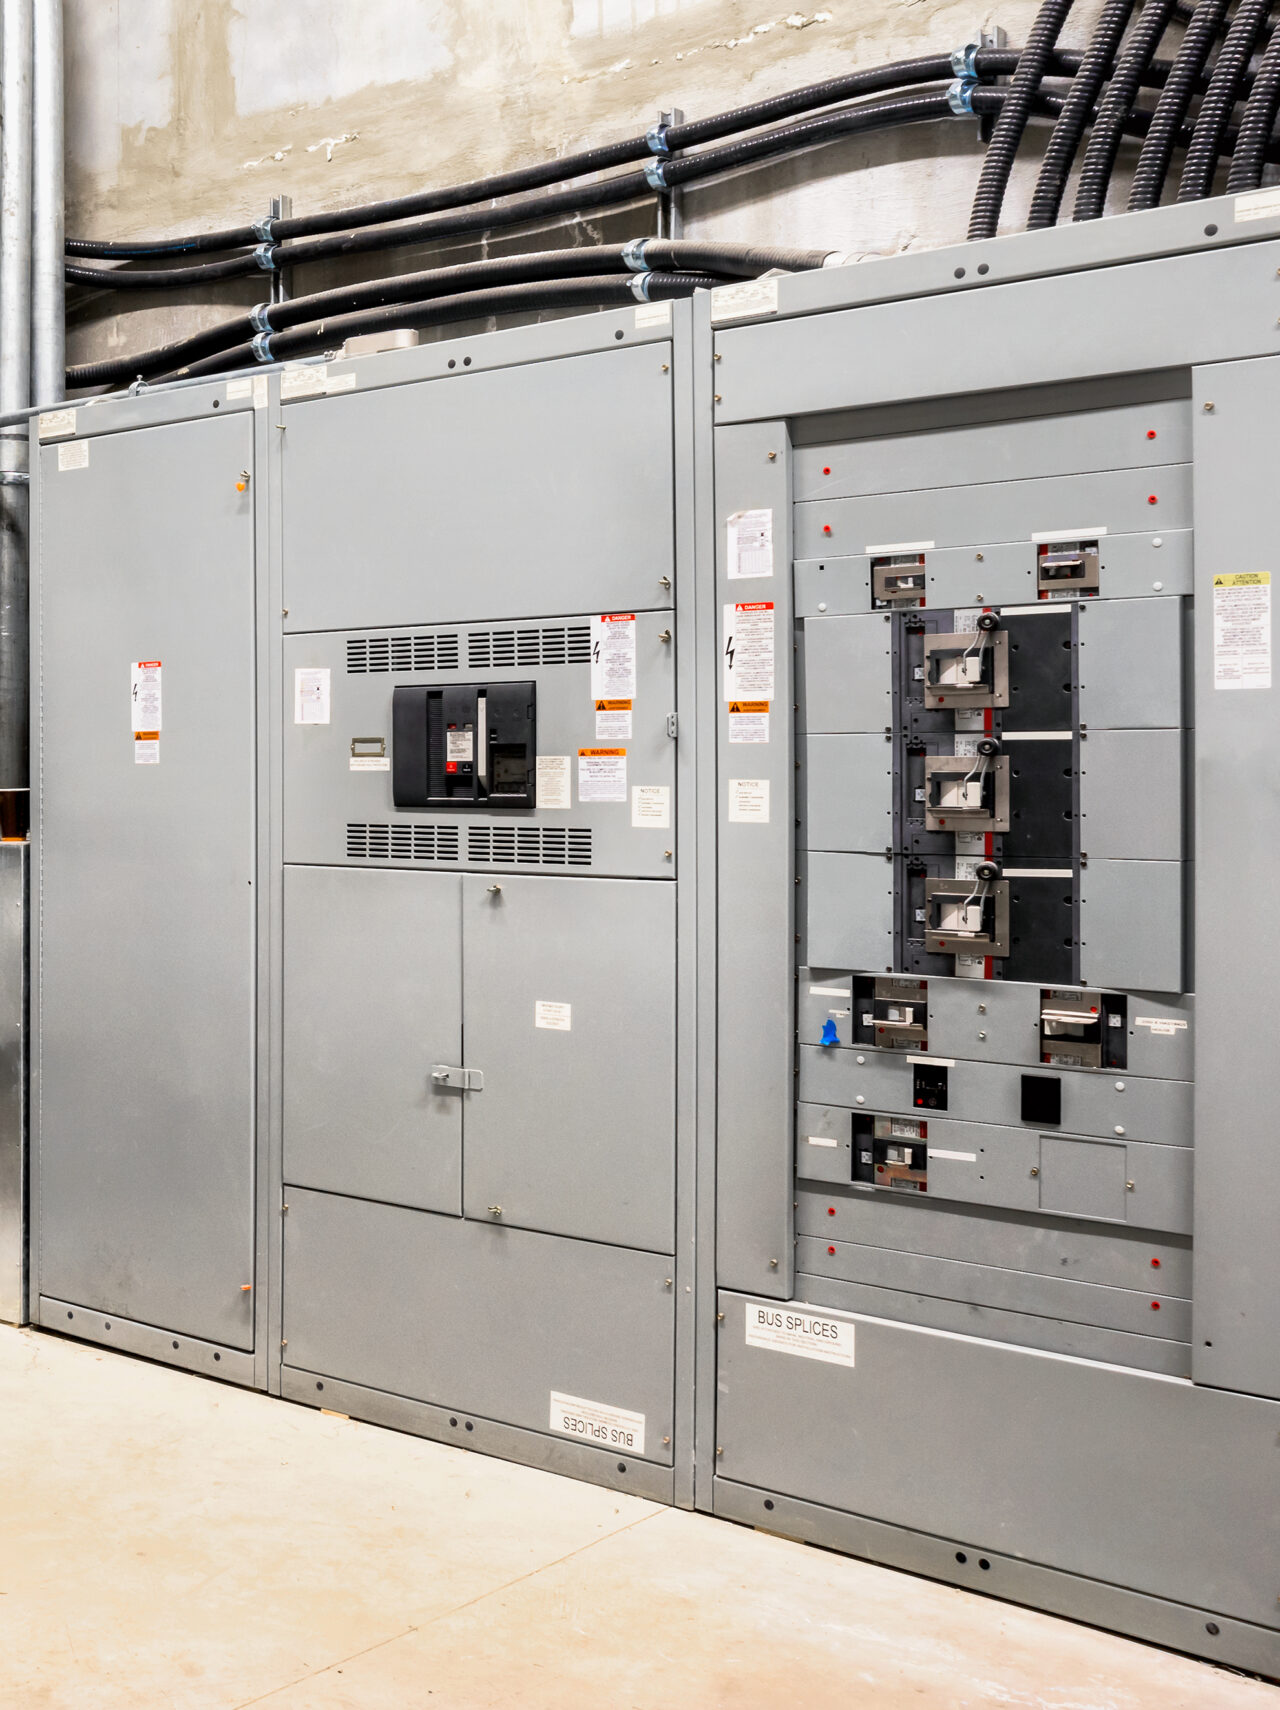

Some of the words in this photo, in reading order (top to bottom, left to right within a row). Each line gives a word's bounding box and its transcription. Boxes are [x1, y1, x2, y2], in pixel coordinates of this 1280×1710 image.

[757, 1310, 783, 1328] BUS
[785, 1316, 839, 1340] SPLICES
[563, 1416, 608, 1440] SPLICES
[611, 1429, 634, 1447] BUS
